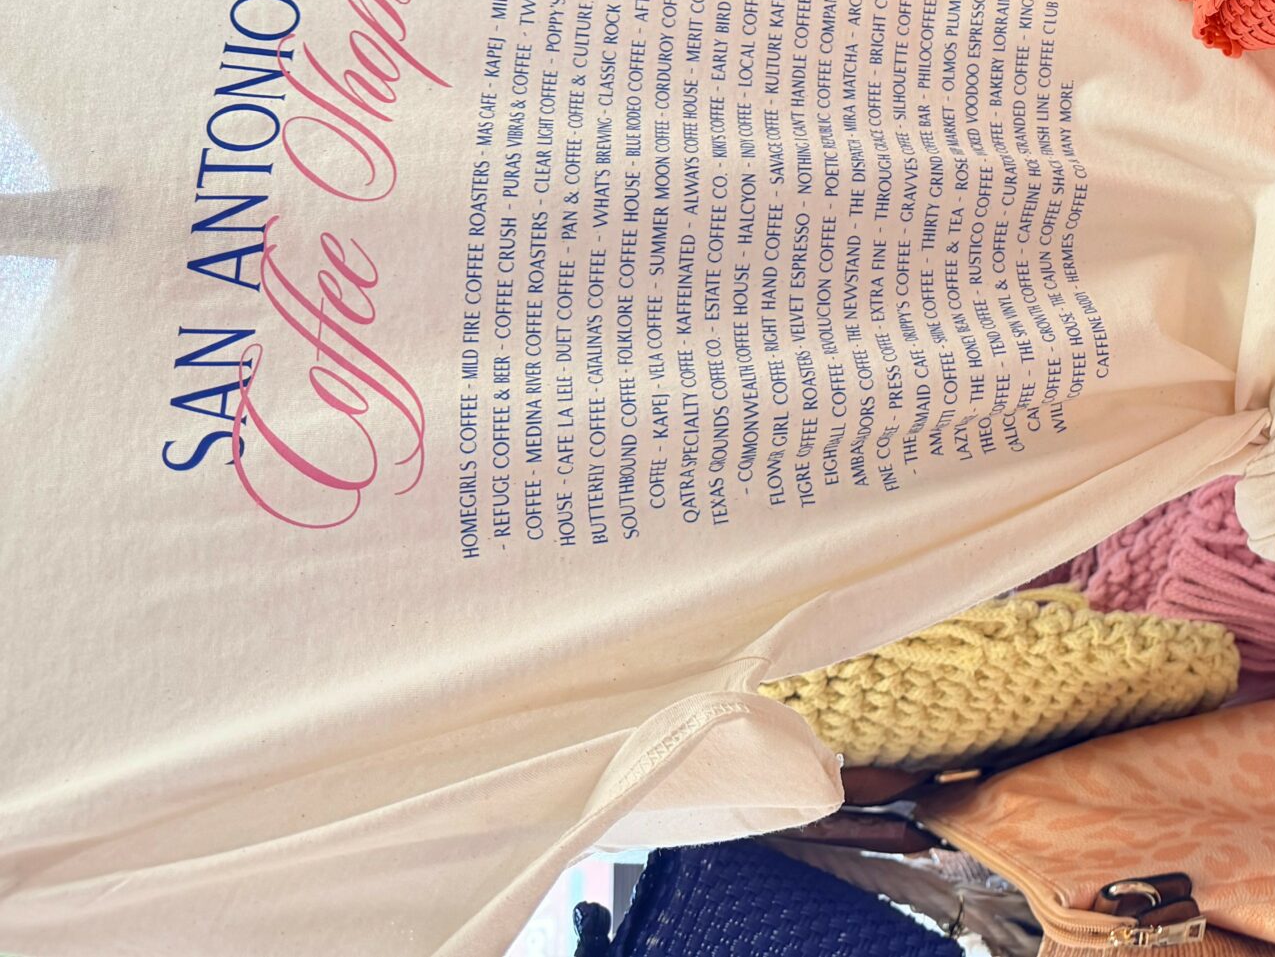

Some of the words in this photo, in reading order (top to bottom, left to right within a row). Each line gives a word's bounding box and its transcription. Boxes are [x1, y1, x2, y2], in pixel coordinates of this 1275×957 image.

[573, 4, 593, 68] CULTURE
[603, 4, 621, 44] ROCK
[715, 2, 732, 33] BIRD
[869, 14, 886, 64] BRIGHT
[1019, 0, 1034, 29] KING
[1043, 2, 1058, 34] CLUB
[686, 18, 703, 62] MERIT
[711, 39, 728, 80] EARLY
[738, 42, 755, 86] LOCAL
[765, 34, 782, 94] KULTURE
[918, 0, 937, 88] PHILOCOFFEE
[1038, 40, 1054, 88] COFFEE
[512, 44, 532, 95] COFFEE
[598, 51, 616, 106] CLASSIC
[628, 40, 646, 92] COFFEE
[655, 33, 674, 109] CORDUROY
[790, 54, 806, 106] HANDLE
[817, 60, 832, 108] COFFEE
[843, 44, 858, 100] MATCHA
[893, 42, 908, 120] SILHOUETTE
[942, 42, 957, 91] OLMOS
[989, 58, 1004, 106] BAKERY
[1014, 46, 1030, 96] COFFEE
[540, 70, 558, 114] COFFEE
[626, 96, 641, 130] RODEO
[683, 80, 698, 119] HOUSE
[868, 81, 881, 126] COFFEE
[918, 105, 931, 126] BAR
[965, 64, 979, 123] VOODOO
[1036, 94, 1050, 120] LINE
[476, 122, 494, 146] MAS
[506, 112, 525, 147] VIBRAS
[537, 117, 554, 145] LIGHT
[737, 103, 753, 136] COFFEE
[843, 105, 856, 131] MIRA
[534, 150, 552, 193] CLEAR
[564, 139, 582, 184] COFFEE
[654, 157, 670, 199] MOON
[684, 157, 699, 215] ALWAYS
[768, 143, 784, 184] SAVAGE
[824, 152, 839, 196] POETIC
[929, 156, 943, 198] GRIND
[954, 158, 968, 190] ROSE
[468, 161, 490, 236] ROASTERS
[592, 170, 610, 228] WHAT'S
[624, 172, 640, 222] HOUSE
[737, 174, 756, 244] HALCYON
[849, 189, 865, 216] THE
[875, 154, 892, 220] THROUGH
[975, 166, 993, 218] COFFEE
[561, 211, 578, 239] PAN
[764, 204, 783, 261] COFFEE
[922, 204, 940, 251] THIRTY
[948, 208, 964, 234] TEA
[1018, 183, 1041, 243] CAFFEINE
[498, 218, 517, 273] CRUSH
[528, 212, 548, 293] ROASTERS
[619, 230, 638, 288] COFFEE
[649, 207, 669, 276] SUMMER
[790, 213, 810, 288] ESPRESSO
[819, 216, 836, 273] COFFEE
[872, 240, 886, 270] FINE
[969, 222, 984, 284] RUSTICO
[992, 221, 1008, 273] COFFEE
[1062, 234, 1079, 282] HERMES
[465, 244, 484, 304] COFFEE
[557, 261, 575, 320] COFFEE
[588, 250, 606, 308] COFFEE
[676, 235, 695, 334] KAFFEINATED
[733, 264, 750, 315] HOUSE
[761, 266, 778, 310] HAND
[843, 236, 860, 319] NEWSTAND
[896, 240, 910, 296] COFFEE
[1040, 252, 1057, 290] CAJUN
[494, 280, 513, 339] COFFEE
[704, 270, 721, 320] ESTATE
[789, 294, 806, 342] VELVET
[870, 277, 885, 321] EXTRA
[921, 270, 938, 319] COFFEE
[463, 311, 480, 342] FIRE
[525, 300, 542, 356] COFFEE
[556, 326, 572, 362] DUET
[617, 295, 633, 364] FOLKLORE
[647, 296, 662, 349] COFFEE
[762, 316, 780, 352] RIGHT
[845, 324, 862, 342] THE
[231, 216, 425, 530] Coffee
[462, 349, 478, 379] MILD
[493, 356, 510, 383] BEER
[586, 315, 604, 384] CATALINA'S
[677, 350, 696, 388] COFFEE
[162, 326, 255, 471] SAN
[525, 361, 542, 394] RIVER
[556, 376, 573, 402] LELE
[619, 377, 637, 427] COFFEE
[795, 351, 818, 410] ROASTERS
[886, 365, 903, 409] PRESS
[970, 374, 984, 404] THE
[460, 394, 478, 454] COFFEE
[492, 406, 510, 469] COFFEE
[526, 399, 542, 463] MEDINA
[558, 408, 574, 427] LA
[589, 397, 606, 458] COFFEE
[772, 412, 789, 446] GIRL
[557, 435, 574, 474] CAFE
[492, 474, 511, 537] REFUGE
[588, 464, 608, 544] BUTTERFLY
[619, 434, 639, 539] SOUTHBOUND
[649, 458, 667, 509] COFFEE
[709, 478, 728, 525] TEXAS
[795, 462, 816, 508] TIGRE
[459, 461, 480, 558] HOMEGIRLS
[525, 480, 544, 540] COFFEE
[557, 492, 576, 546] HOUSE
